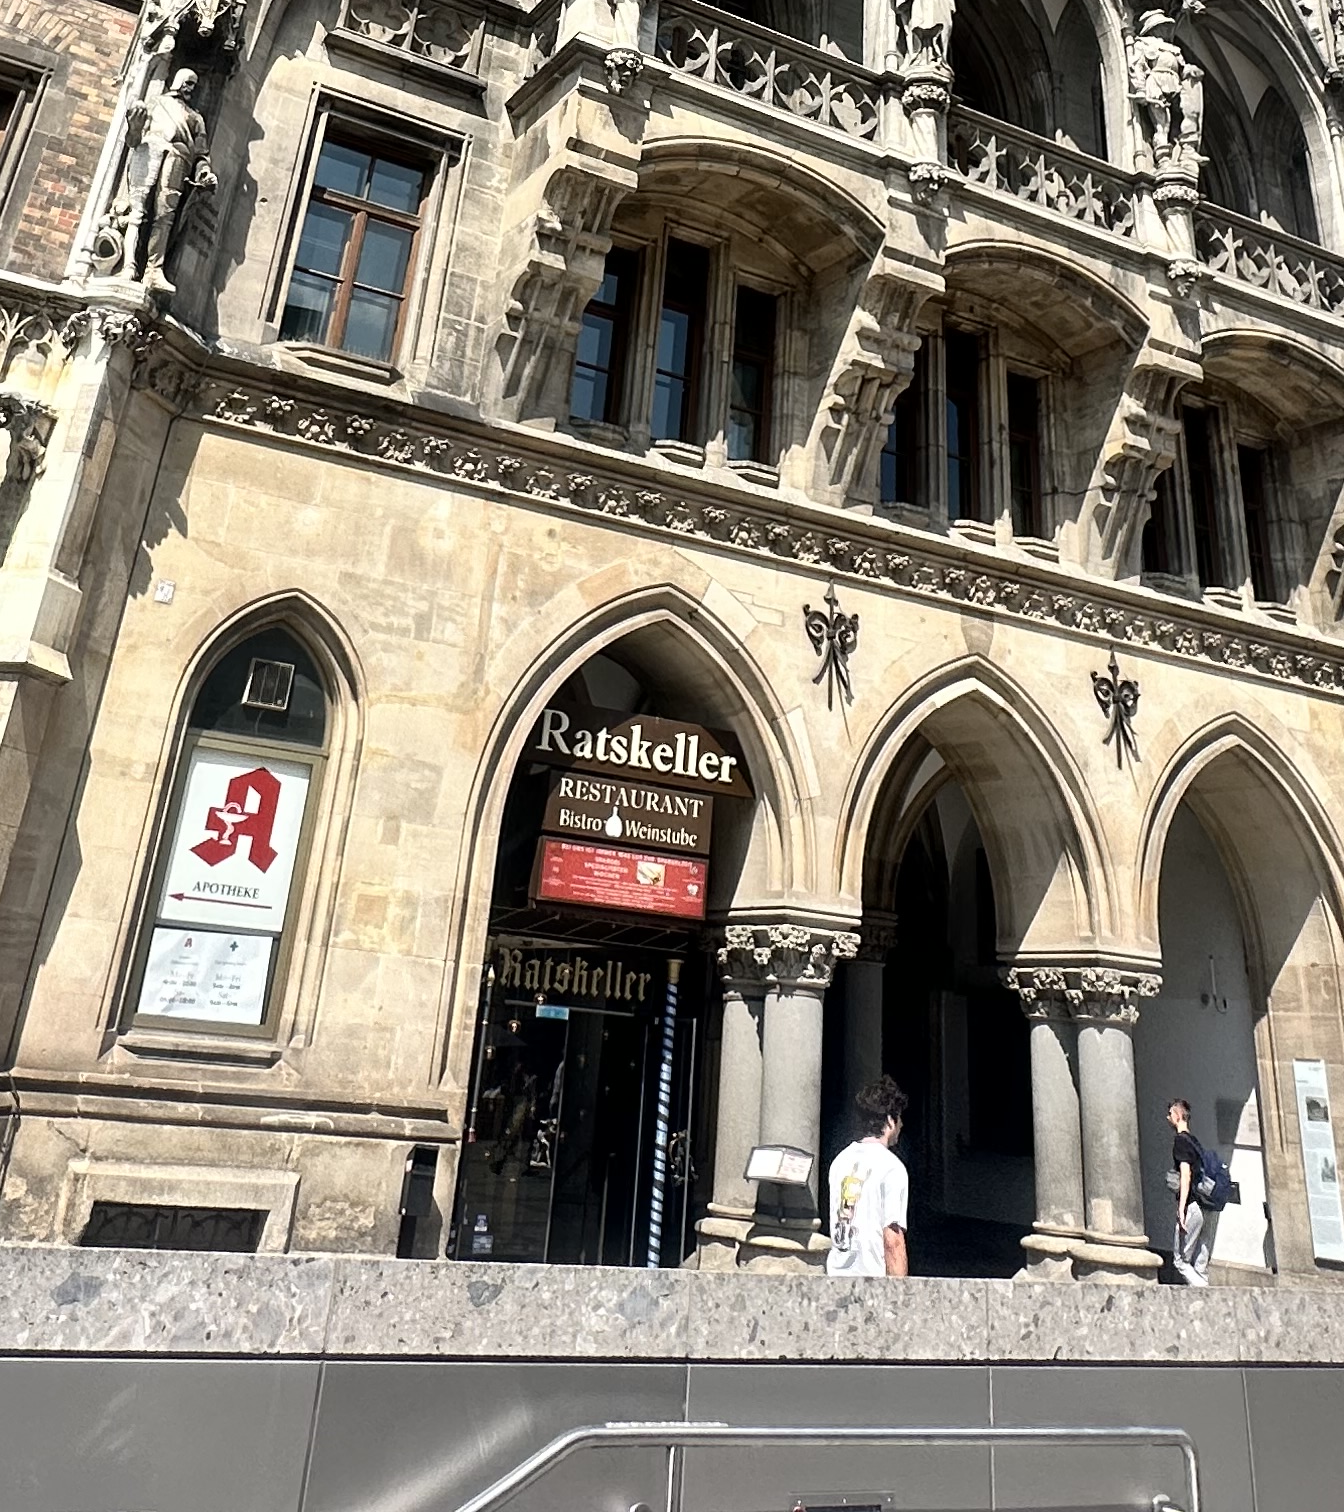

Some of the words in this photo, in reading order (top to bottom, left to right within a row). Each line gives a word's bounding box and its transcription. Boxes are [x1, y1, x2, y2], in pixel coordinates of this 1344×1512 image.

[536, 709, 738, 783] Ratskeller
[558, 777, 704, 818] RESTAURANT
[559, 809, 602, 831] Bistro
[625, 819, 697, 847] Weinstube
[192, 881, 260, 899] APOTHEKE
[498, 947, 651, 1002] Ratskeller
